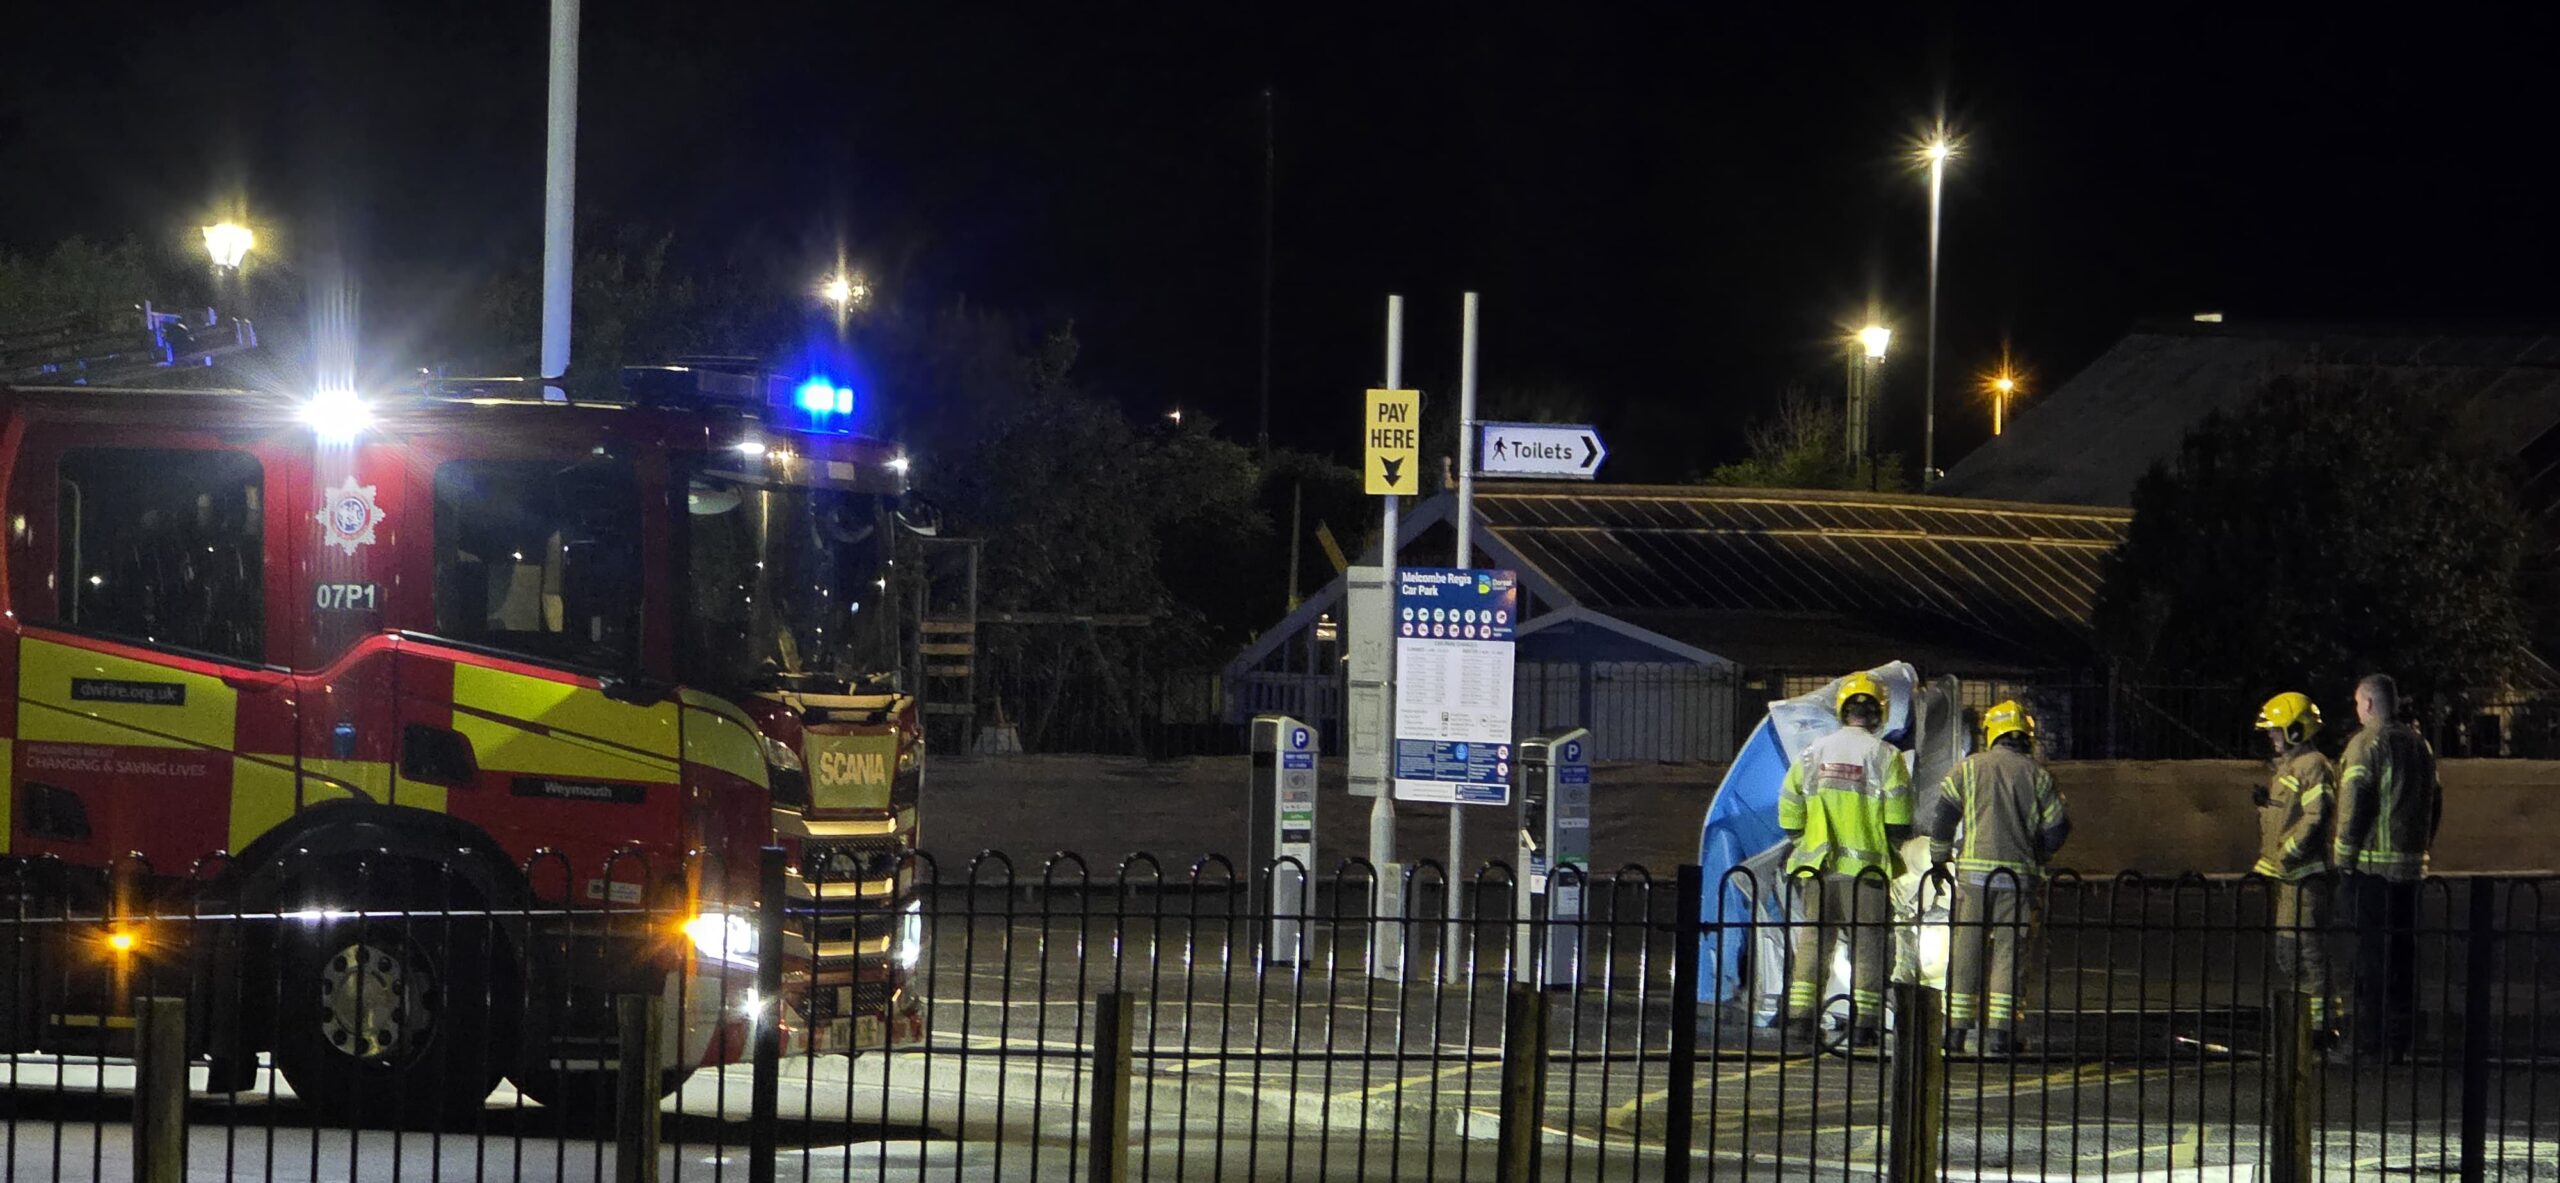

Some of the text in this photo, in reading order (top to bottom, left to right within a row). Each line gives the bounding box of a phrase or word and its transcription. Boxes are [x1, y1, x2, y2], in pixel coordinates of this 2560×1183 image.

[1378, 402, 1409, 423] PAY
[1371, 429, 1414, 449] HERE
[1511, 441, 1573, 460] Toilets
[1402, 572, 1472, 587] Melcombe Regis
[316, 584, 375, 609] 07P1
[1402, 584, 1439, 596] Car Park
[80, 683, 179, 701] dwfire.org.uk
[1296, 731, 1306, 747] P
[1568, 743, 1579, 760] P
[26, 756, 207, 777] CHANGING & SAVING LIVES
[820, 751, 886, 786] SCANIA
[544, 781, 613, 798] Weymouth
